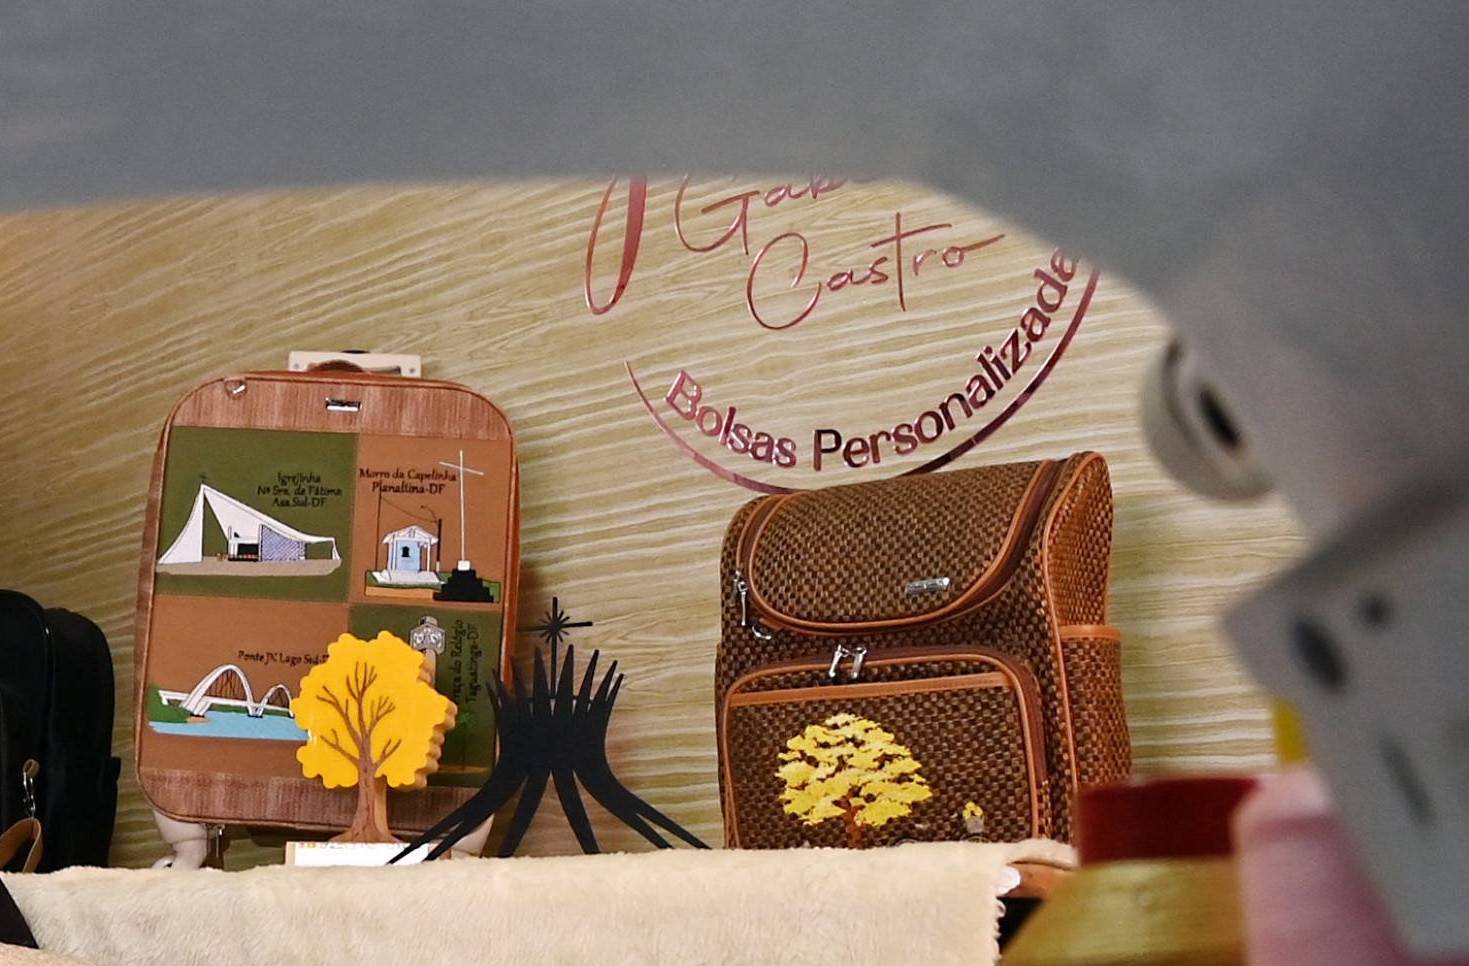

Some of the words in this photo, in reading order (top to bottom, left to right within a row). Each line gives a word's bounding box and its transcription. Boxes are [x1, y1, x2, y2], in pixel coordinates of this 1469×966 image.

[747, 212, 1006, 330] Castro
[665, 370, 798, 470] Bolsas
[812, 246, 1081, 472] Personalizada
[359, 467, 390, 479] Morro
[407, 468, 457, 483] Capelinha
